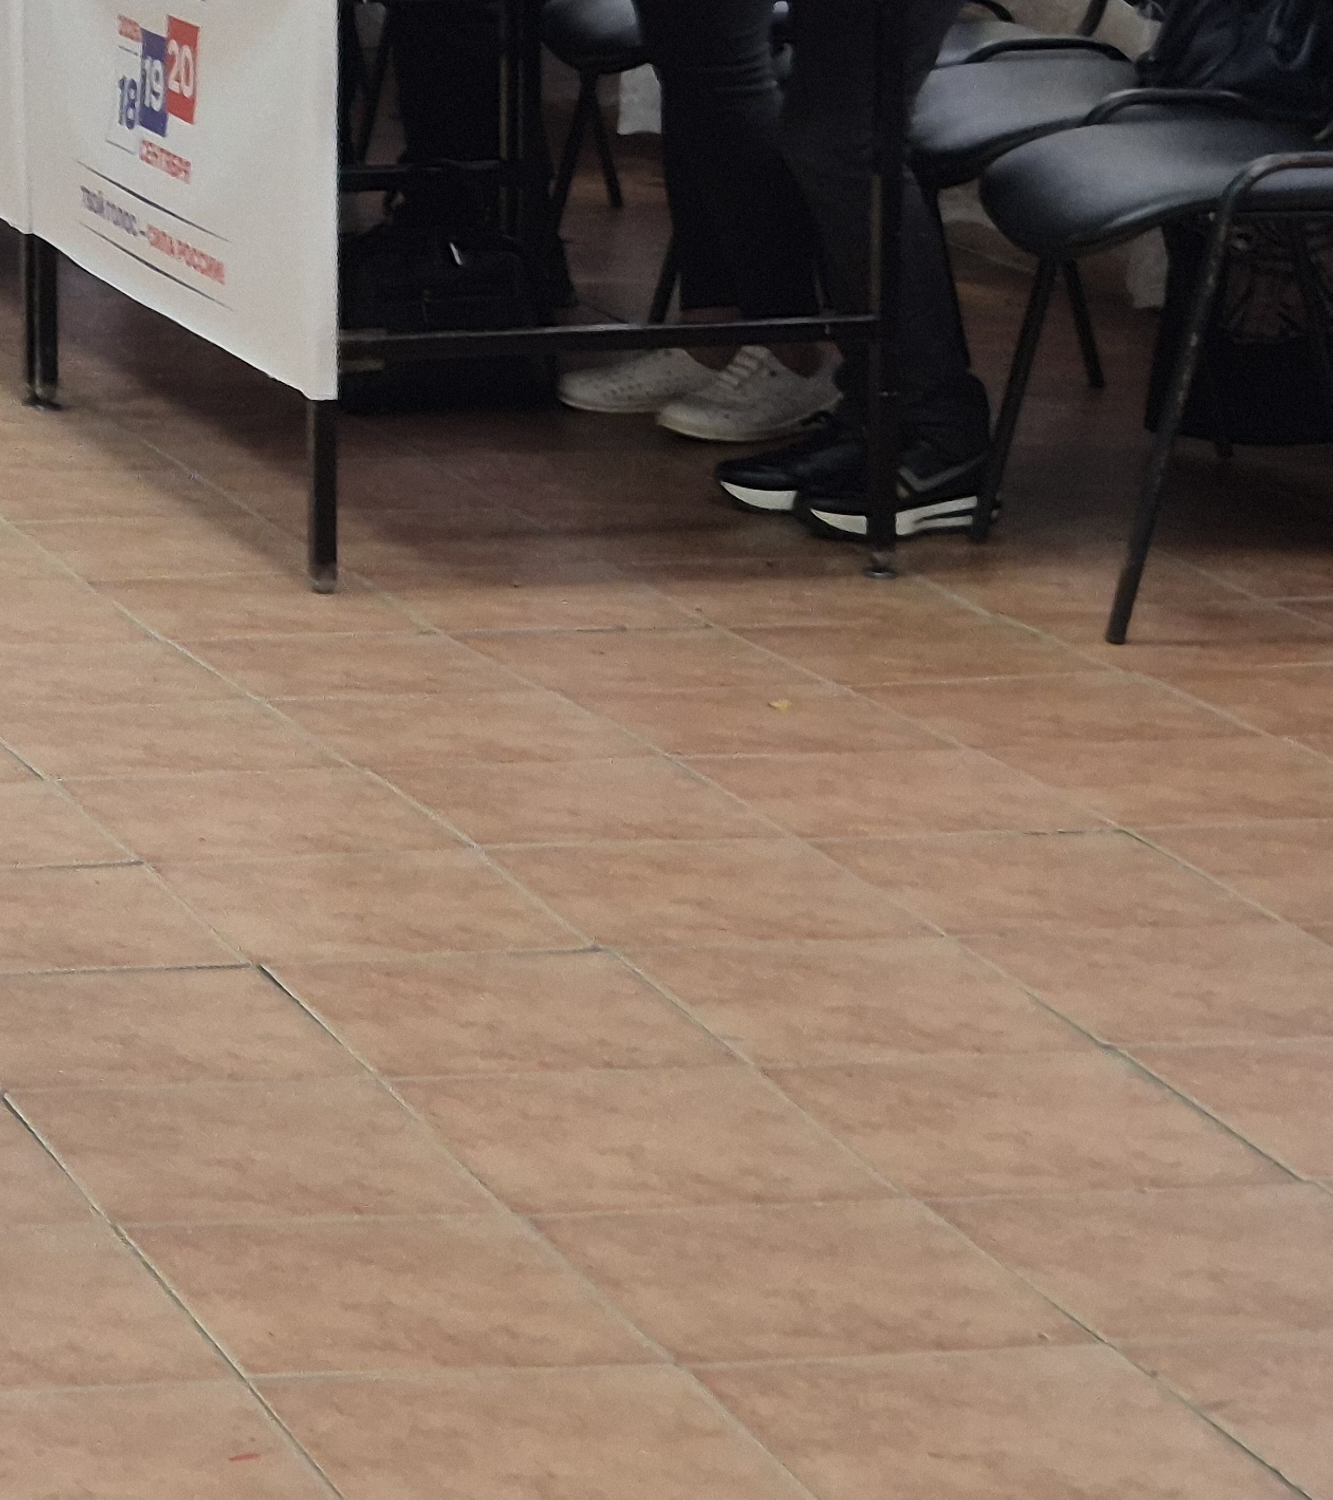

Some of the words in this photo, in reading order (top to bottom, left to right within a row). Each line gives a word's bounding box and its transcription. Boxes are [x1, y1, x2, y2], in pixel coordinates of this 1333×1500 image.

[118, 74, 139, 130] 18
[143, 55, 165, 112] 19
[166, 39, 194, 99] 20
